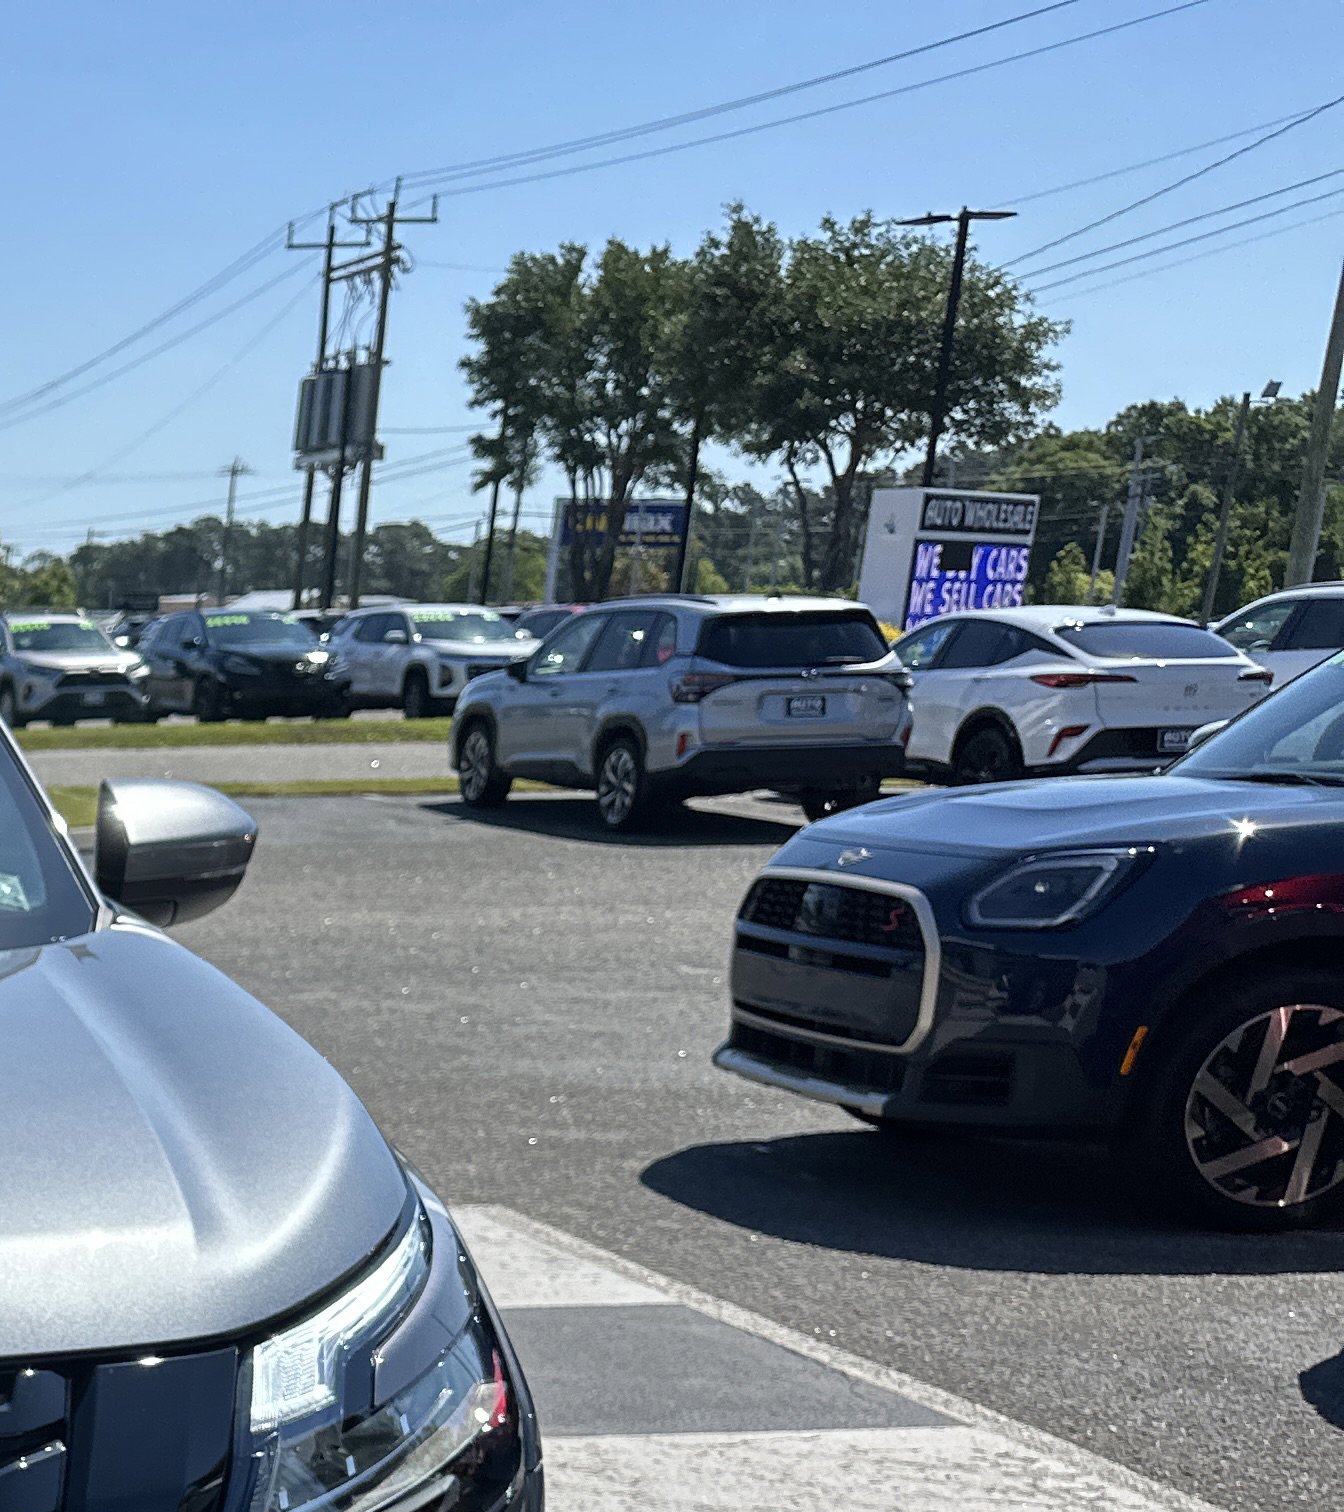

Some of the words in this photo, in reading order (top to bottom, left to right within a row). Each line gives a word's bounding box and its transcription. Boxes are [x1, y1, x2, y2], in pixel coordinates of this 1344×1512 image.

[923, 498, 963, 528] AUTO
[915, 543, 944, 580] WE
[986, 546, 1030, 581] CARS
[909, 580, 936, 614] WE
[938, 580, 977, 613] SELL
[982, 582, 1024, 608] CARS
